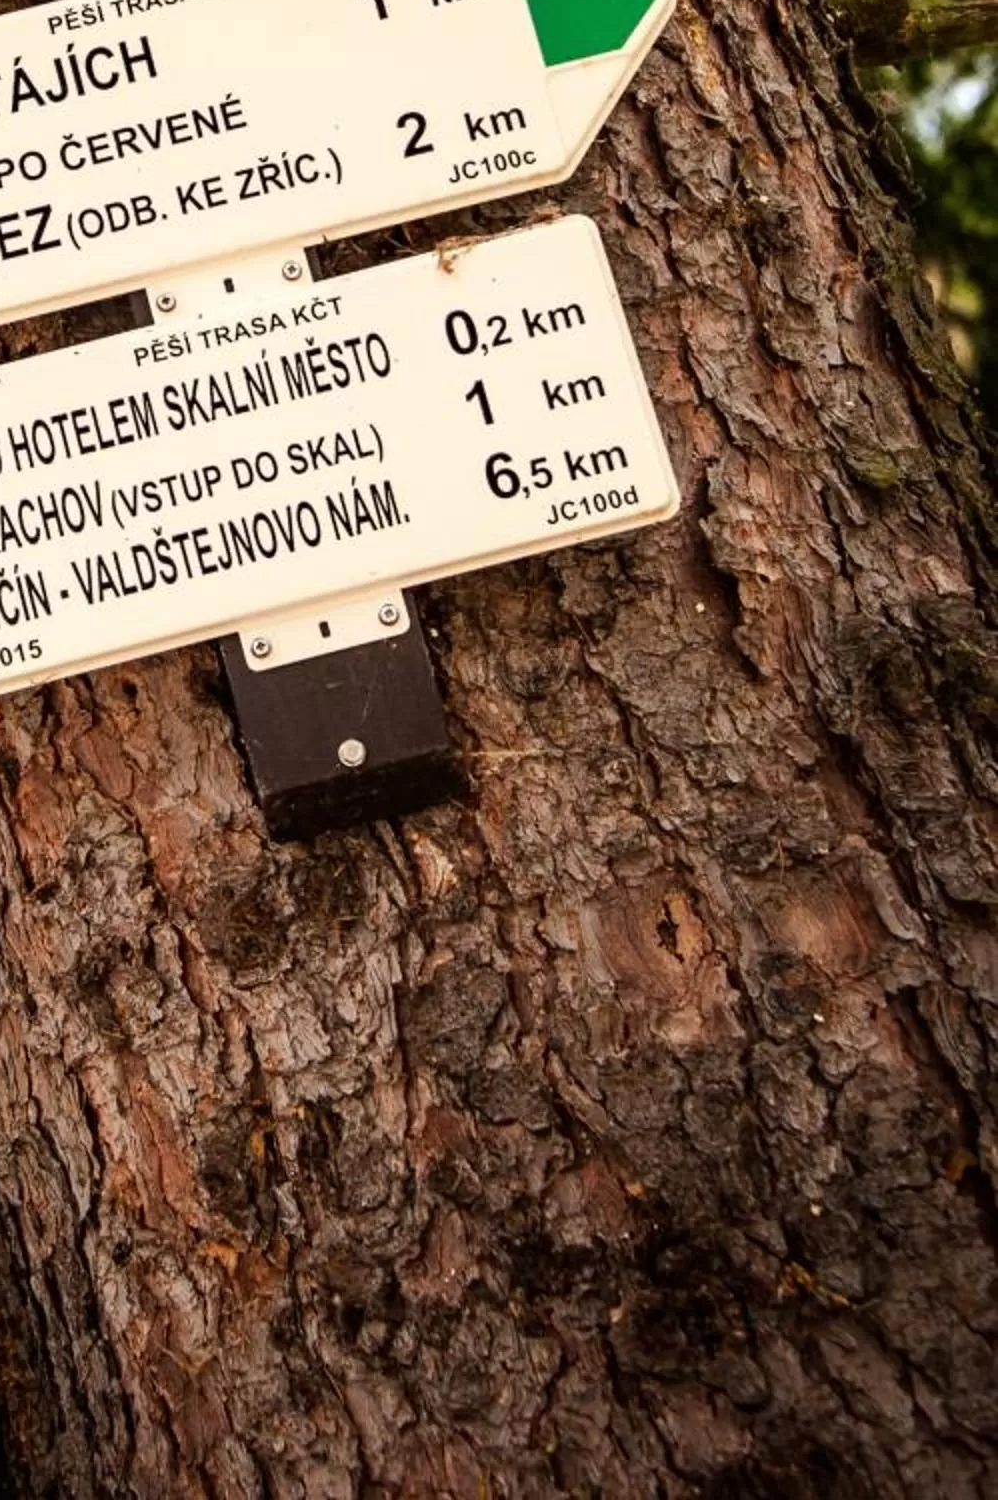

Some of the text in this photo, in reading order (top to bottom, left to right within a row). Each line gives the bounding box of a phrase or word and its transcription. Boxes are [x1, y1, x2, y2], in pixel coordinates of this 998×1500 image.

[47, 0, 105, 35] PĚŠÍ
[59, 92, 248, 171] ČERVENÉ
[396, 107, 527, 159] 2 km
[448, 149, 537, 184] JC100c
[66, 195, 168, 251] (ODB.
[175, 175, 229, 215] KE
[234, 147, 343, 201] ZŘÍC.)
[133, 295, 341, 367] PĚŠÍ TRASA KČT
[444, 303, 586, 357] 0,2 km
[7, 391, 160, 473] HOTELEM
[162, 348, 279, 431] SKALNÍ
[279, 332, 391, 401] MĚSTO
[465, 375, 606, 426] 1 km
[111, 465, 222, 530] (VSTUP
[230, 451, 279, 490] DO
[286, 423, 384, 475] SKAL)
[485, 445, 629, 500] 6,5 km
[546, 485, 639, 525] JC100d
[70, 500, 322, 605] VALDŠTEJNOVO
[325, 475, 411, 541] NÁM.
